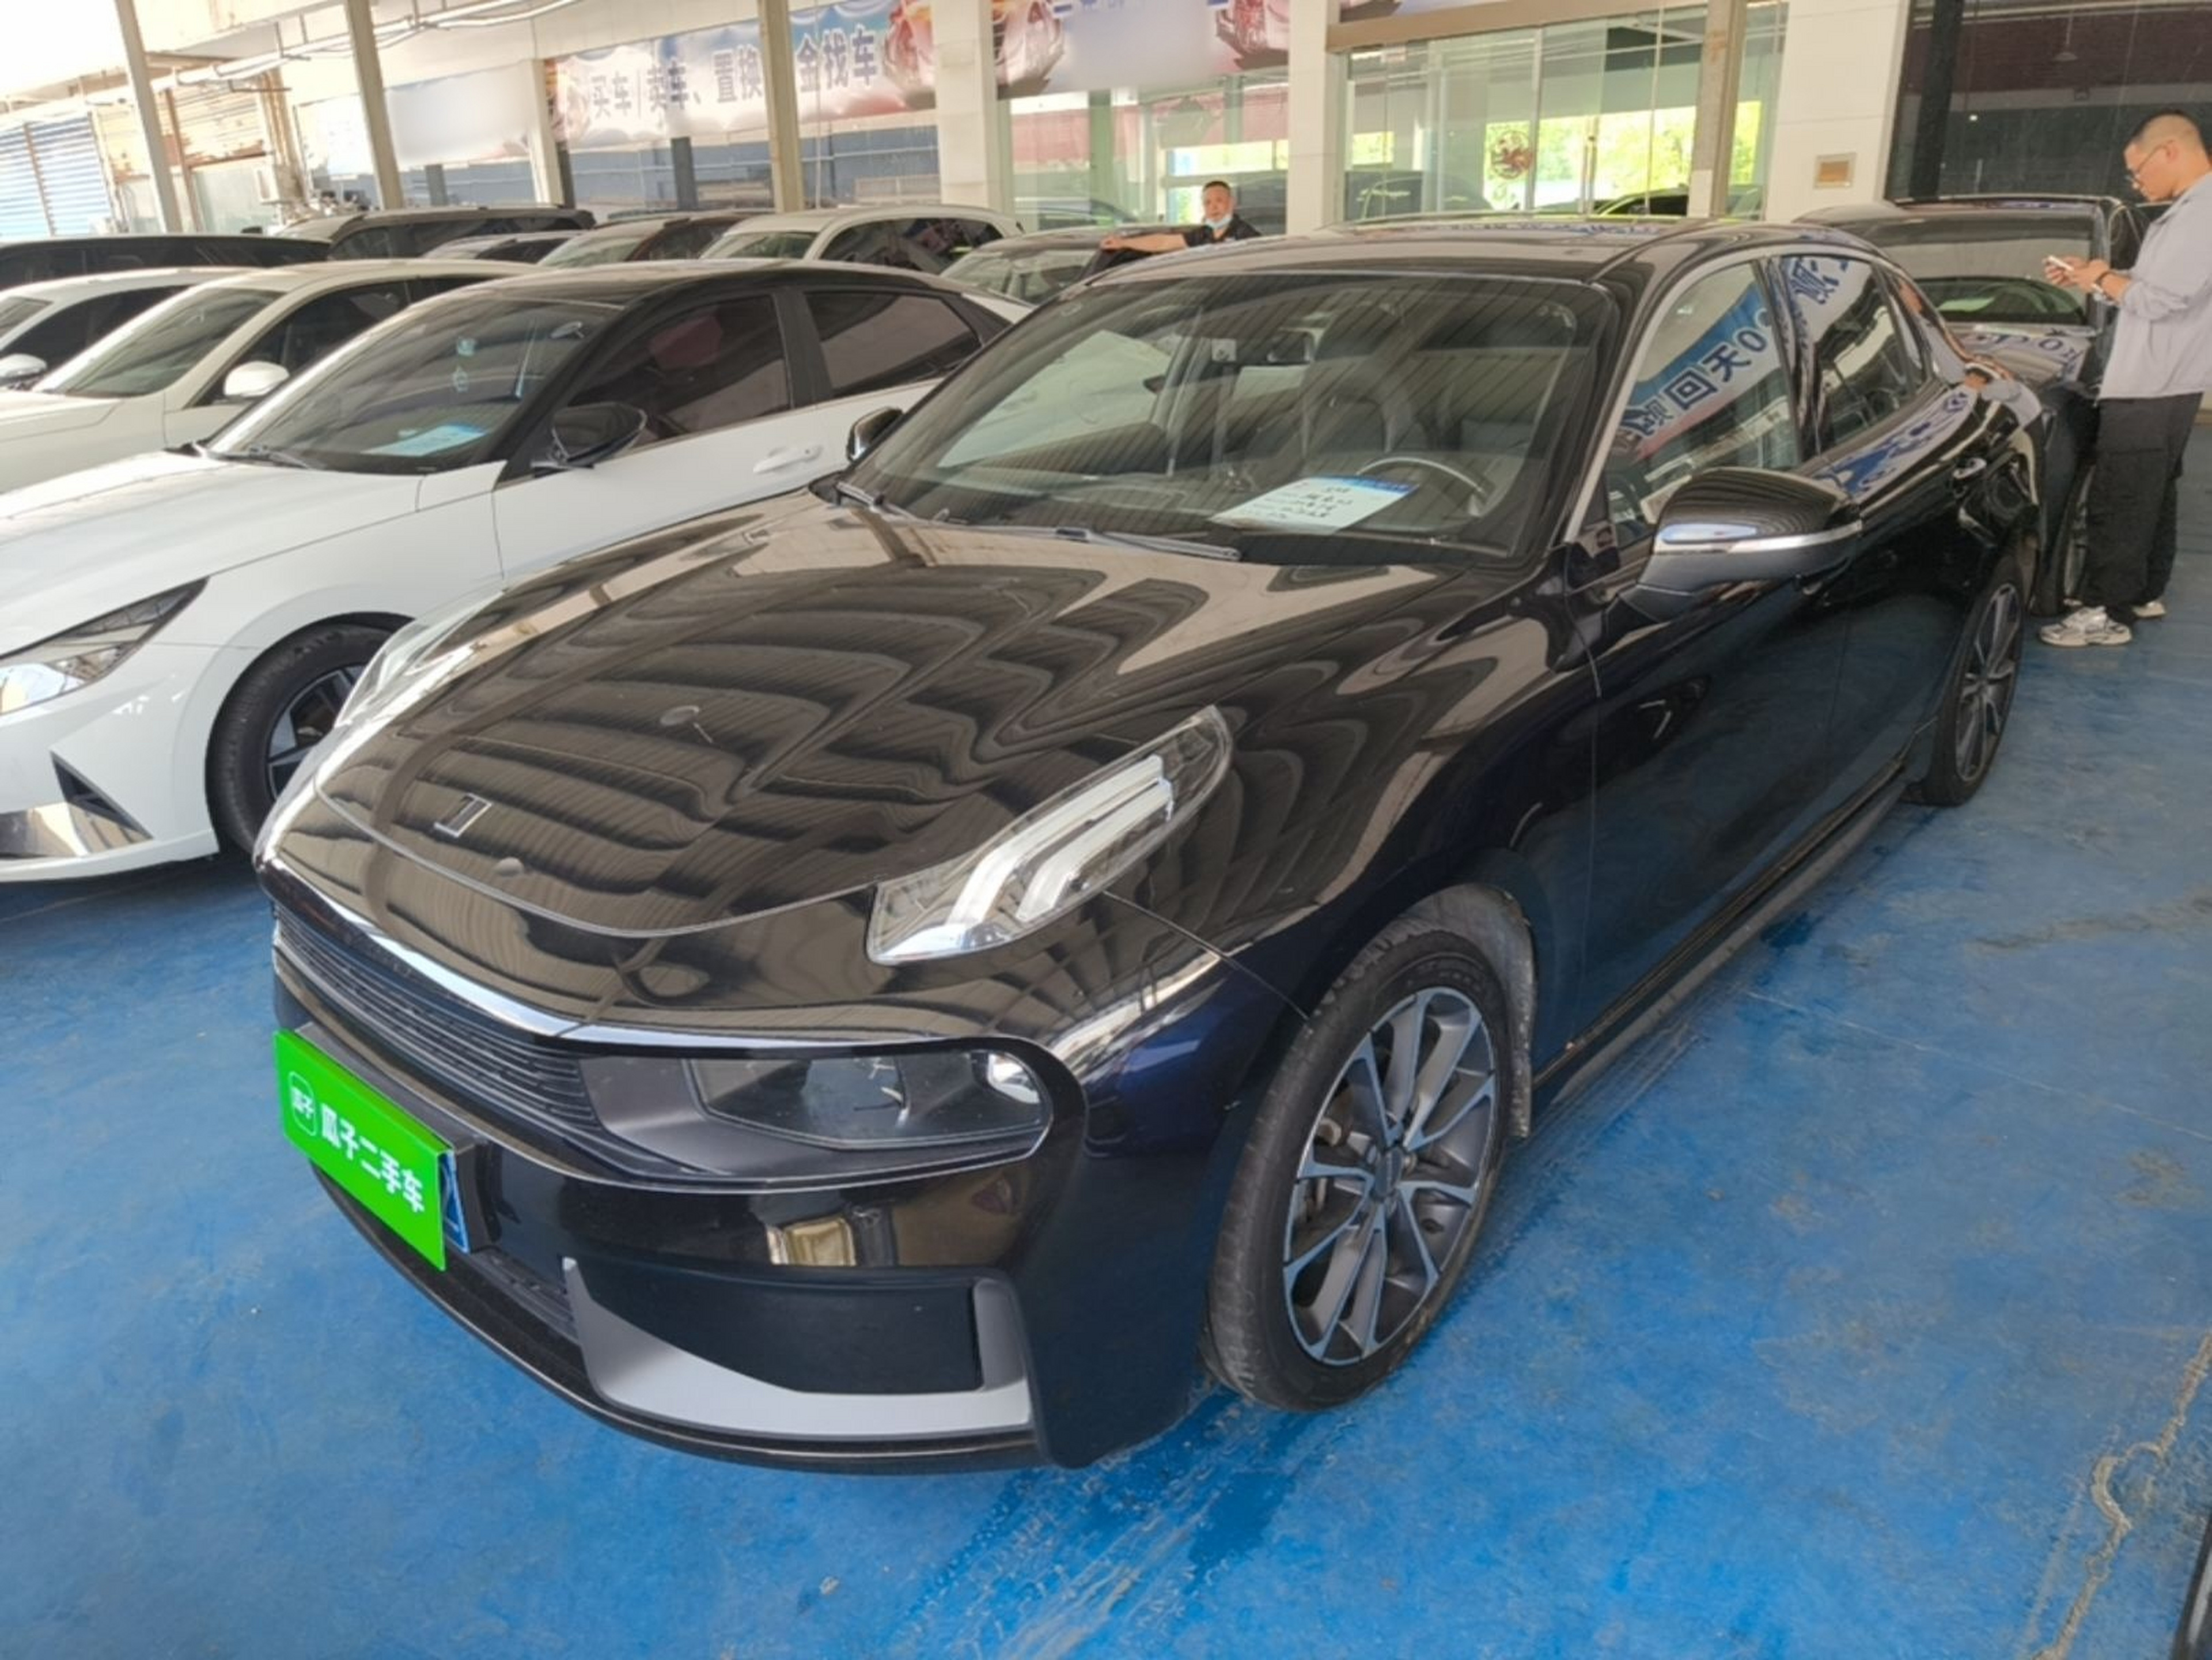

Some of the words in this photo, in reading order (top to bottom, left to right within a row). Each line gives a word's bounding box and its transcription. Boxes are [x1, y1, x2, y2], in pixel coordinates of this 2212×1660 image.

[321, 1103, 426, 1213] 瓜子二手车
